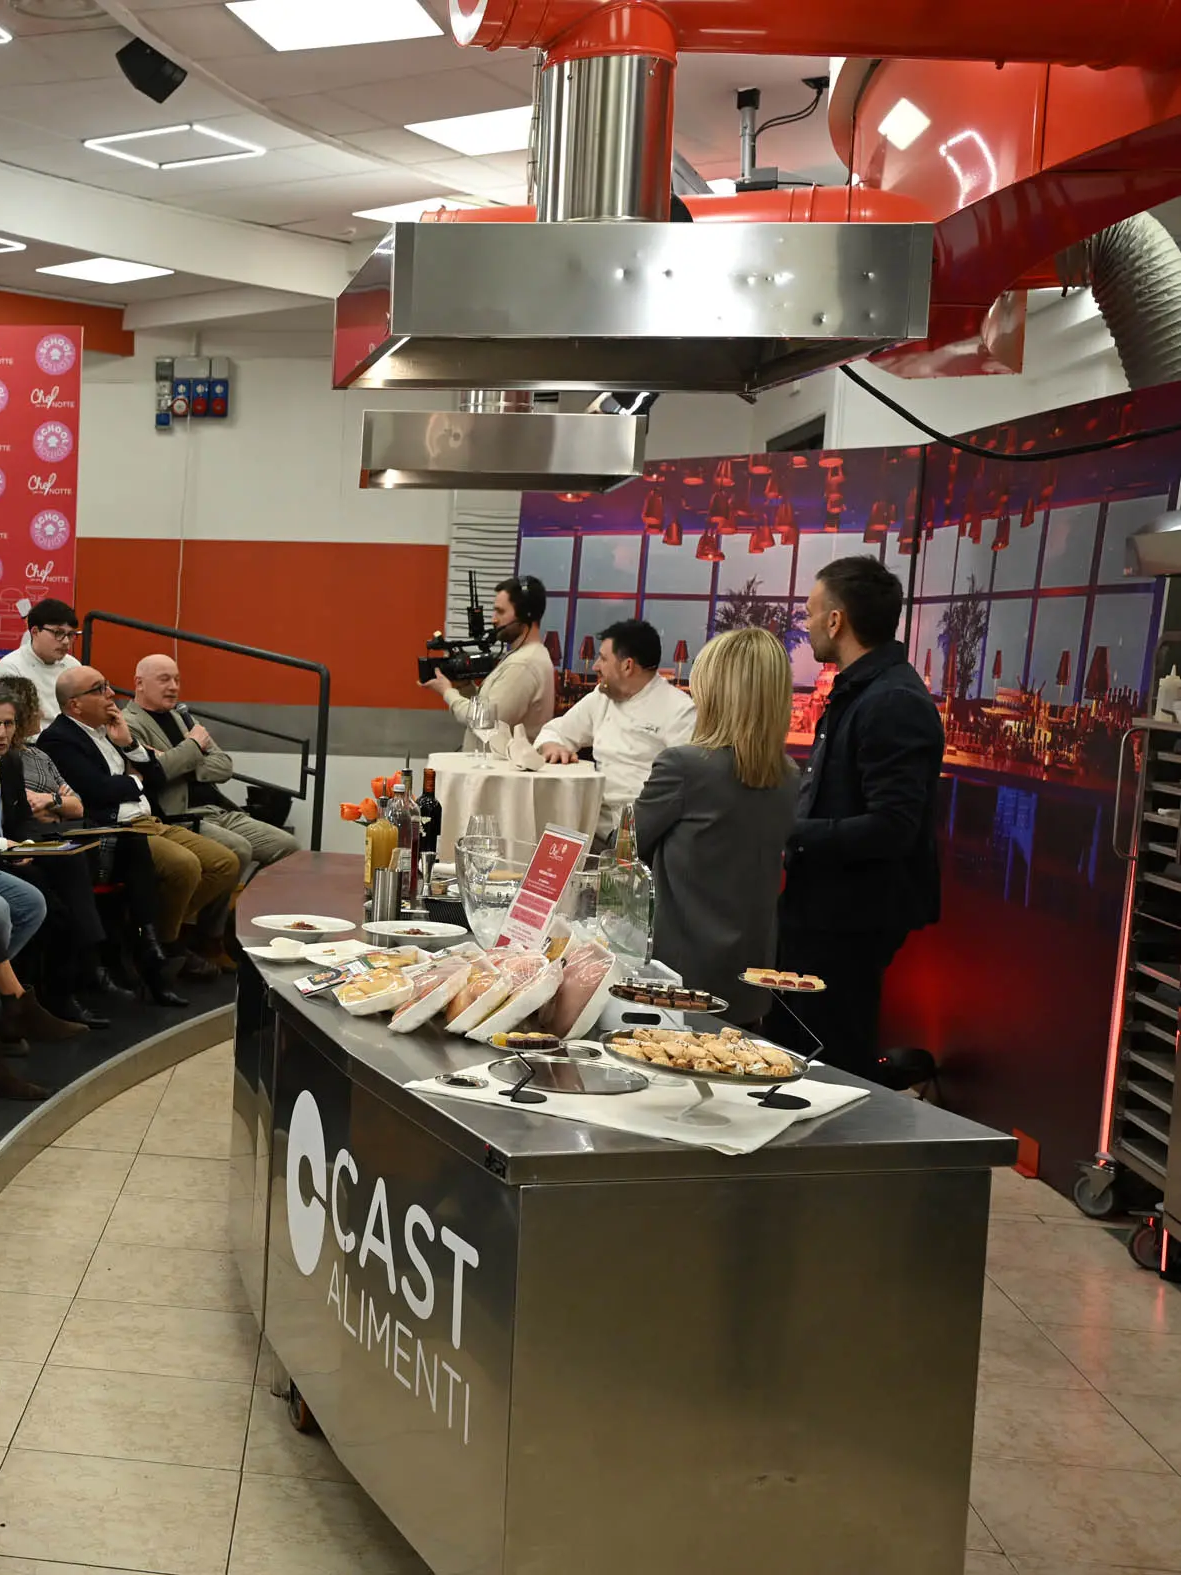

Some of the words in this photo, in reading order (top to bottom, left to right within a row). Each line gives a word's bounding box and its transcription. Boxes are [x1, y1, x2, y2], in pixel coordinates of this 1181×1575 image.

[39, 337, 72, 358] SCHOOL
[31, 386, 59, 409] Chef
[37, 424, 69, 445] SCHOOL
[28, 472, 57, 495] Chef
[34, 513, 66, 534] SCHOOL
[25, 561, 54, 583] Chef
[331, 1148, 479, 1350] CAST
[327, 1261, 470, 1445] ALIMENTI
